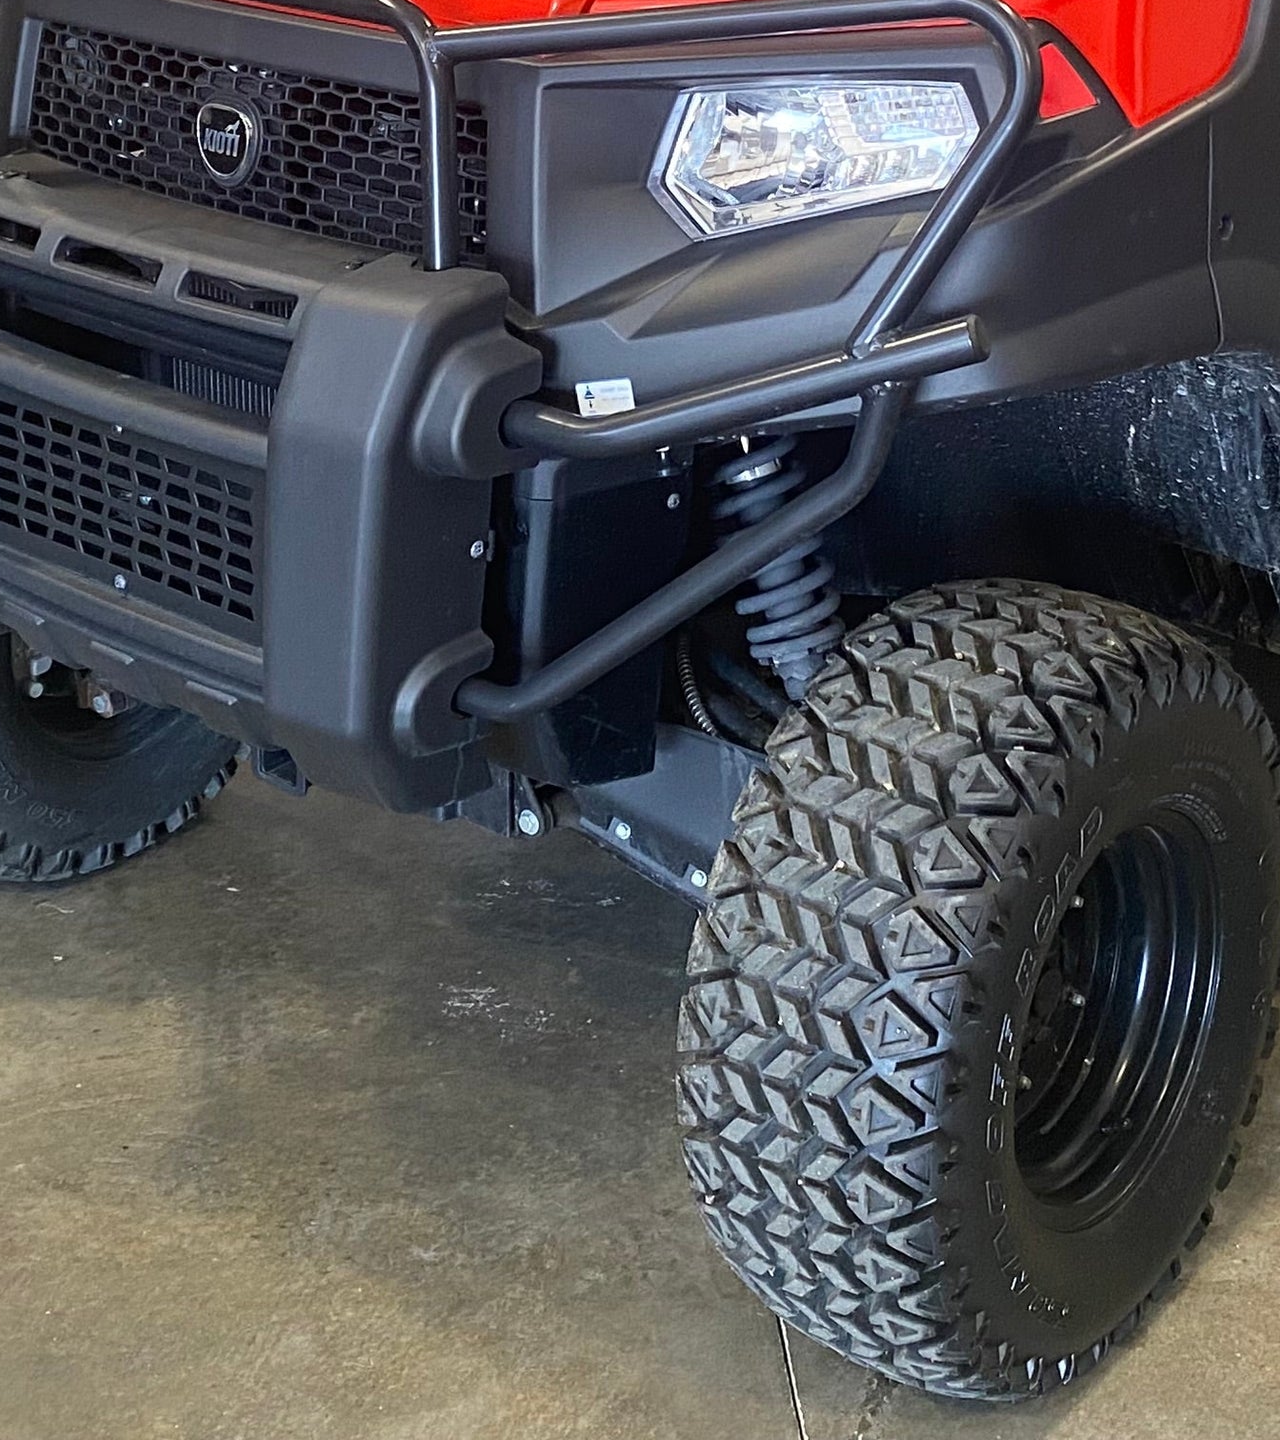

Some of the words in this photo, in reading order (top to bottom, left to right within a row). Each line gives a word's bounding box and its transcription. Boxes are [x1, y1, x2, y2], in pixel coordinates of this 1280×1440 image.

[203, 127, 241, 158] KIOTI
[985, 1012, 1016, 1155] OFF
[1014, 805, 1104, 999] ROAD
